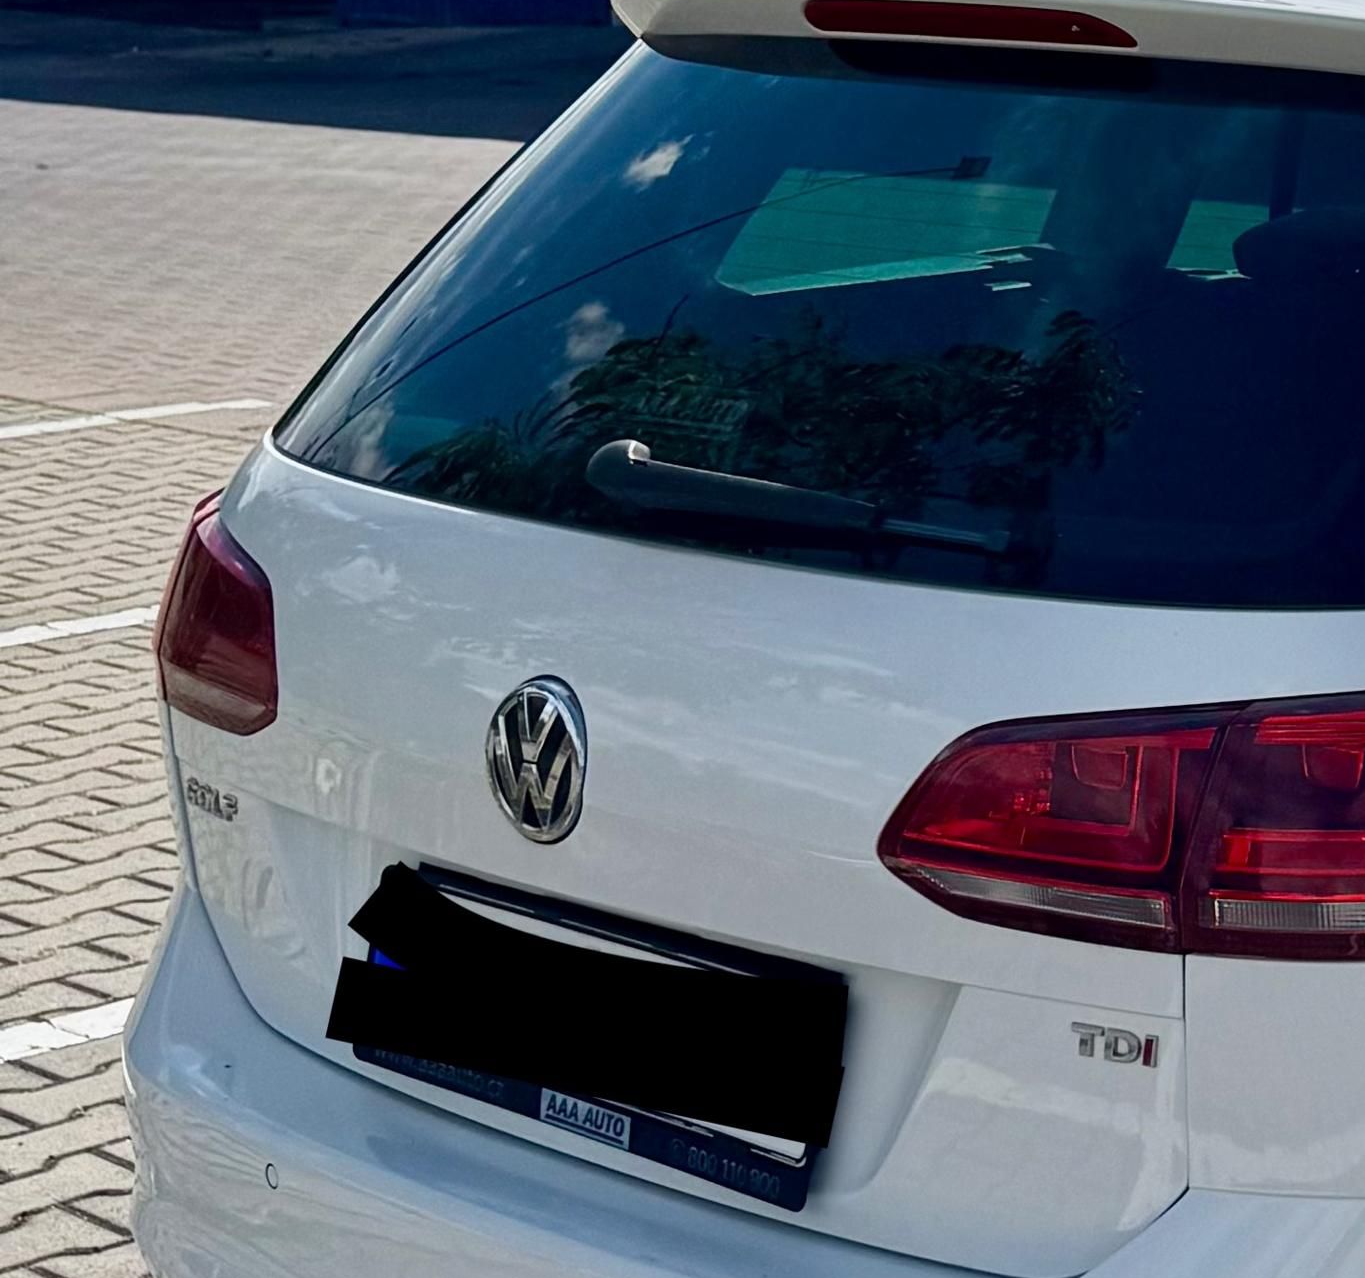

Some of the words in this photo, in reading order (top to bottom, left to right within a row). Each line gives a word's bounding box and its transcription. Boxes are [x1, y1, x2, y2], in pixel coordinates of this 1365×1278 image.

[1070, 1021, 1159, 1068] TDI
[546, 1092, 579, 1122] AAA
[583, 1108, 625, 1137] AUTO
